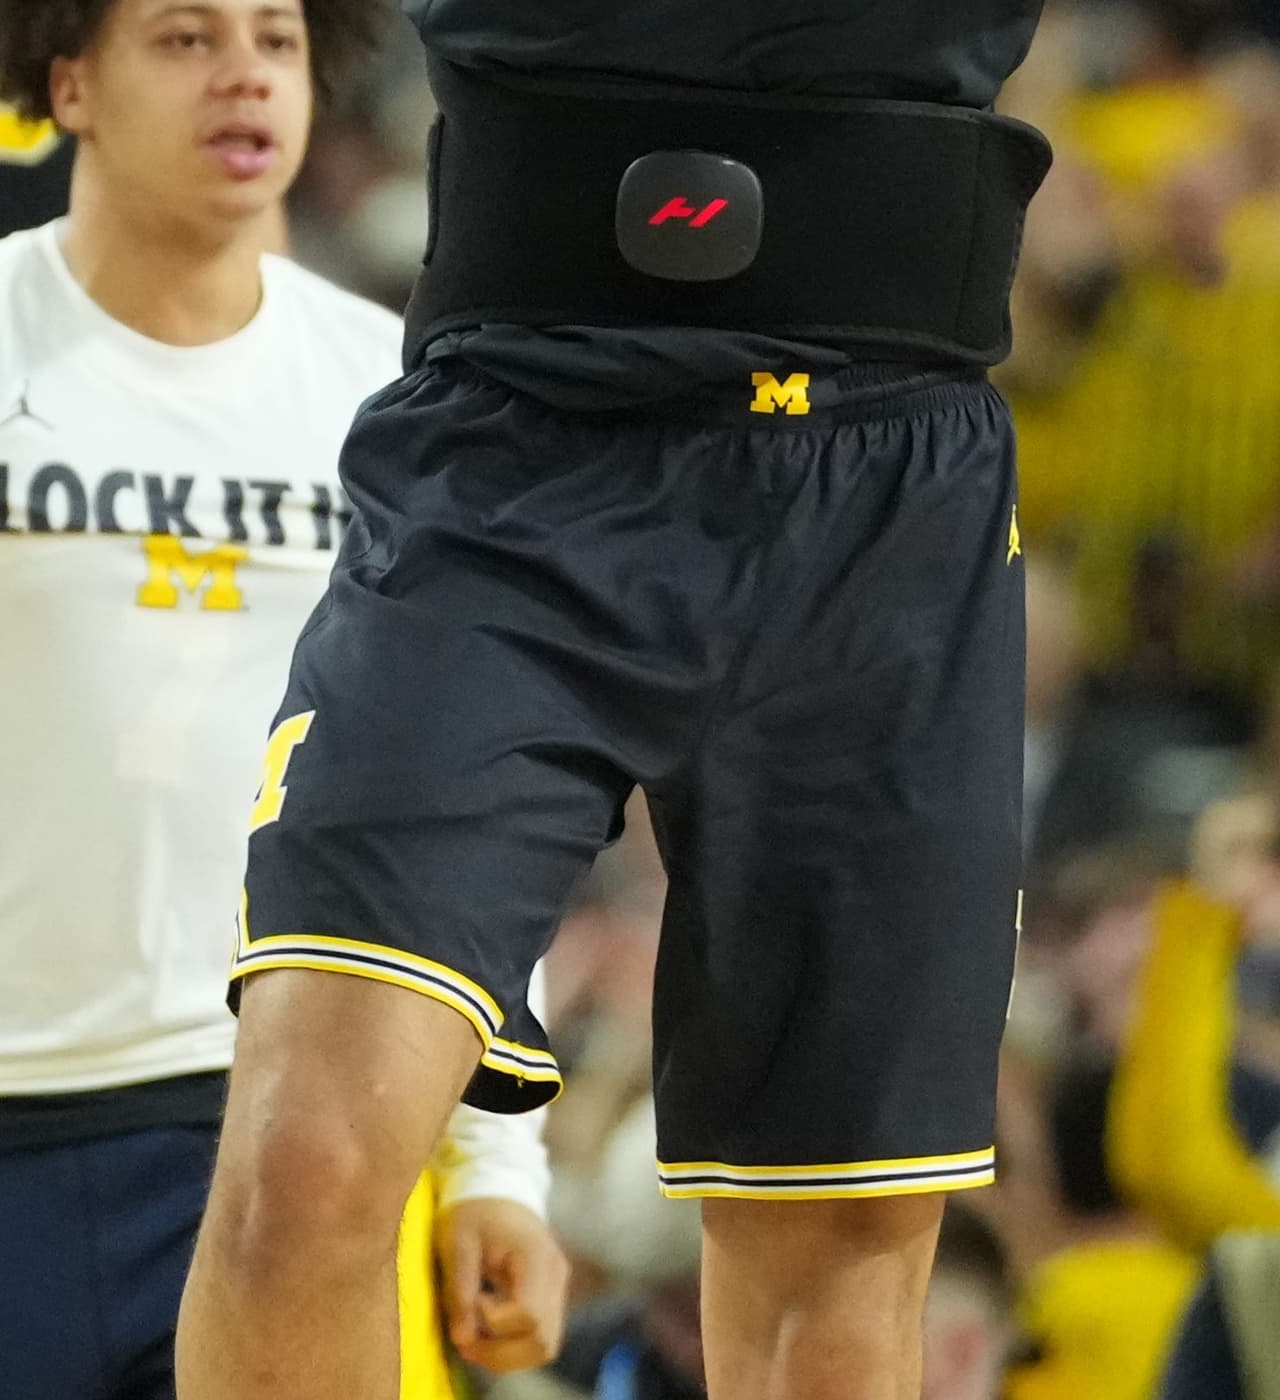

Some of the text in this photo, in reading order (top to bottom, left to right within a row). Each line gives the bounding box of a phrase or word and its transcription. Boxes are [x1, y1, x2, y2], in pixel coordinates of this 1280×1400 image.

[750, 371, 811, 415] M
[220, 479, 292, 546] IT
[135, 533, 250, 611] M
